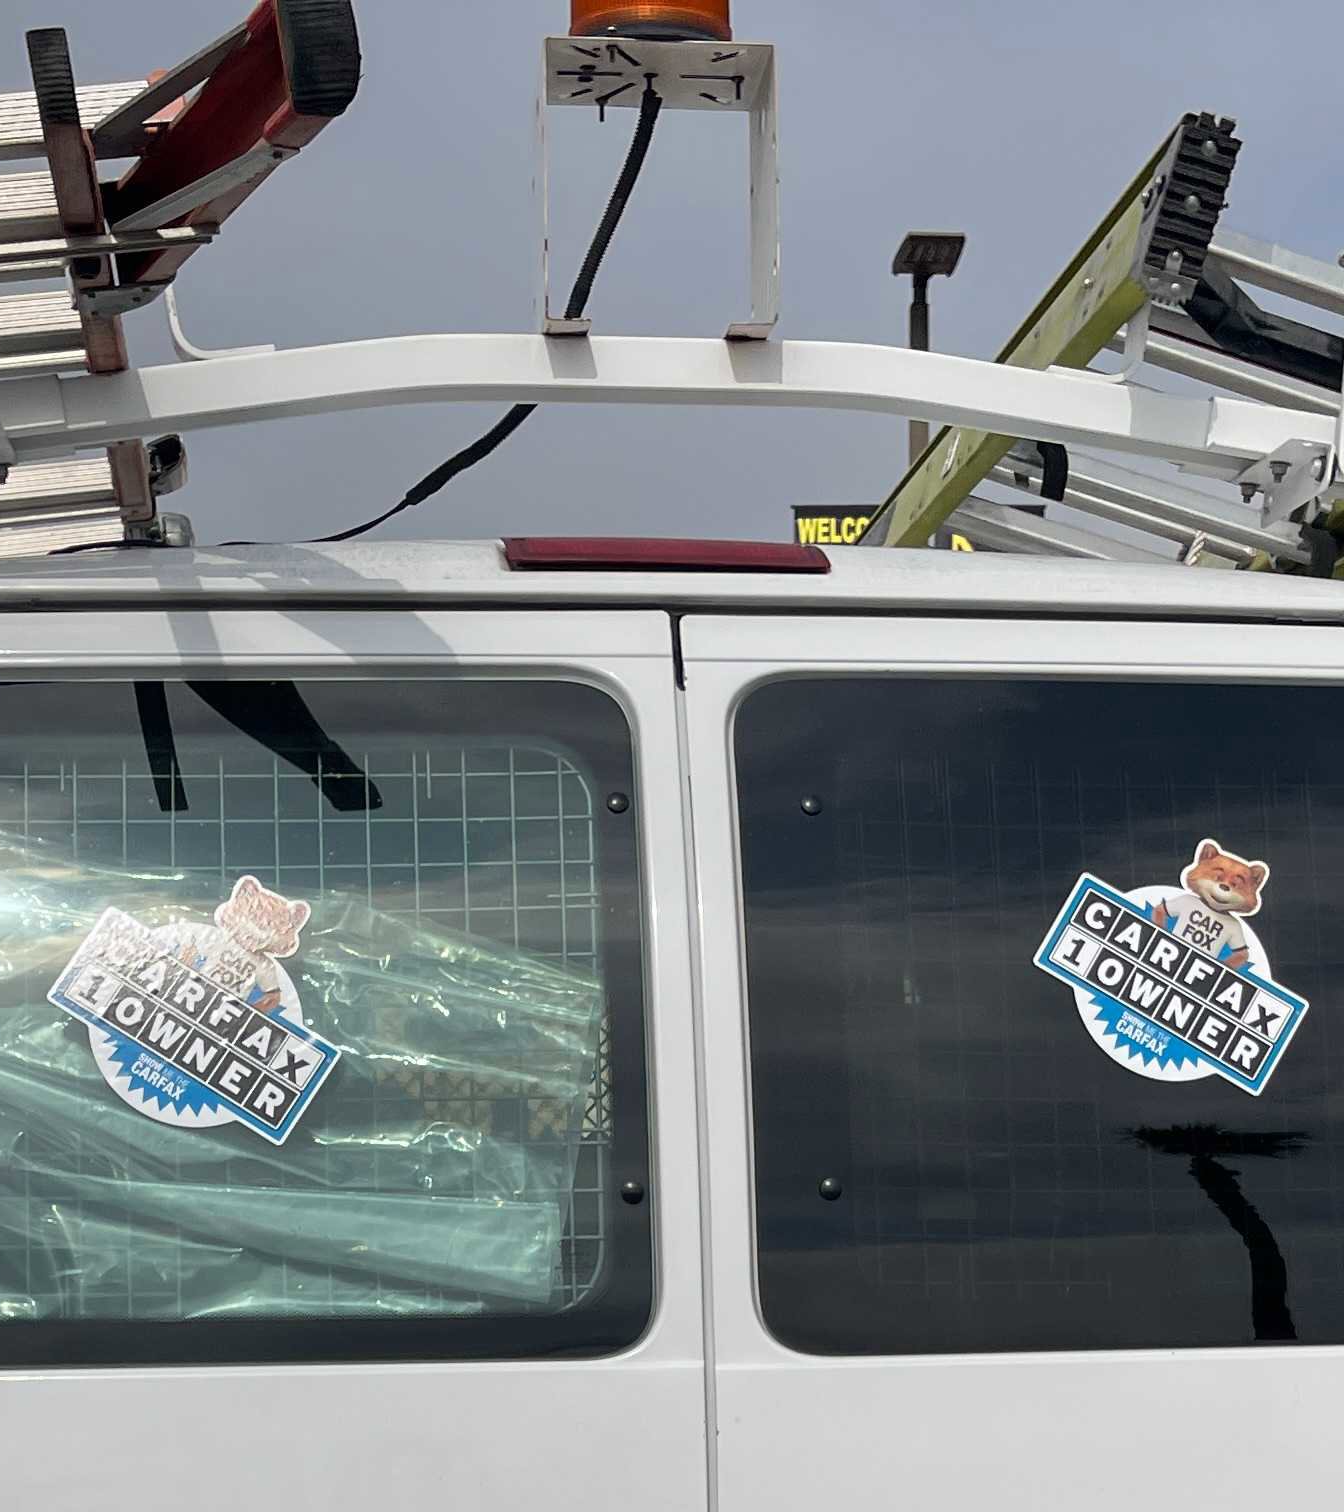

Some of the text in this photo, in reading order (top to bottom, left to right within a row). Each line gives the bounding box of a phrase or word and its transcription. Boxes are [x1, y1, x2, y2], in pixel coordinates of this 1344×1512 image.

[1181, 924, 1216, 950] FOX
[1189, 910, 1224, 937] CAR
[210, 969, 247, 993] FOX
[220, 950, 256, 977] CAR
[1084, 902, 1280, 1037] CARFAX
[131, 955, 310, 1085] ARFAX
[1062, 938, 1260, 1070] 1 OWNER
[78, 975, 285, 1118] 1 OWNER
[1116, 1020, 1167, 1056] CARFAX
[138, 1053, 164, 1072] SHOW
[131, 1061, 186, 1101] CARFAX
